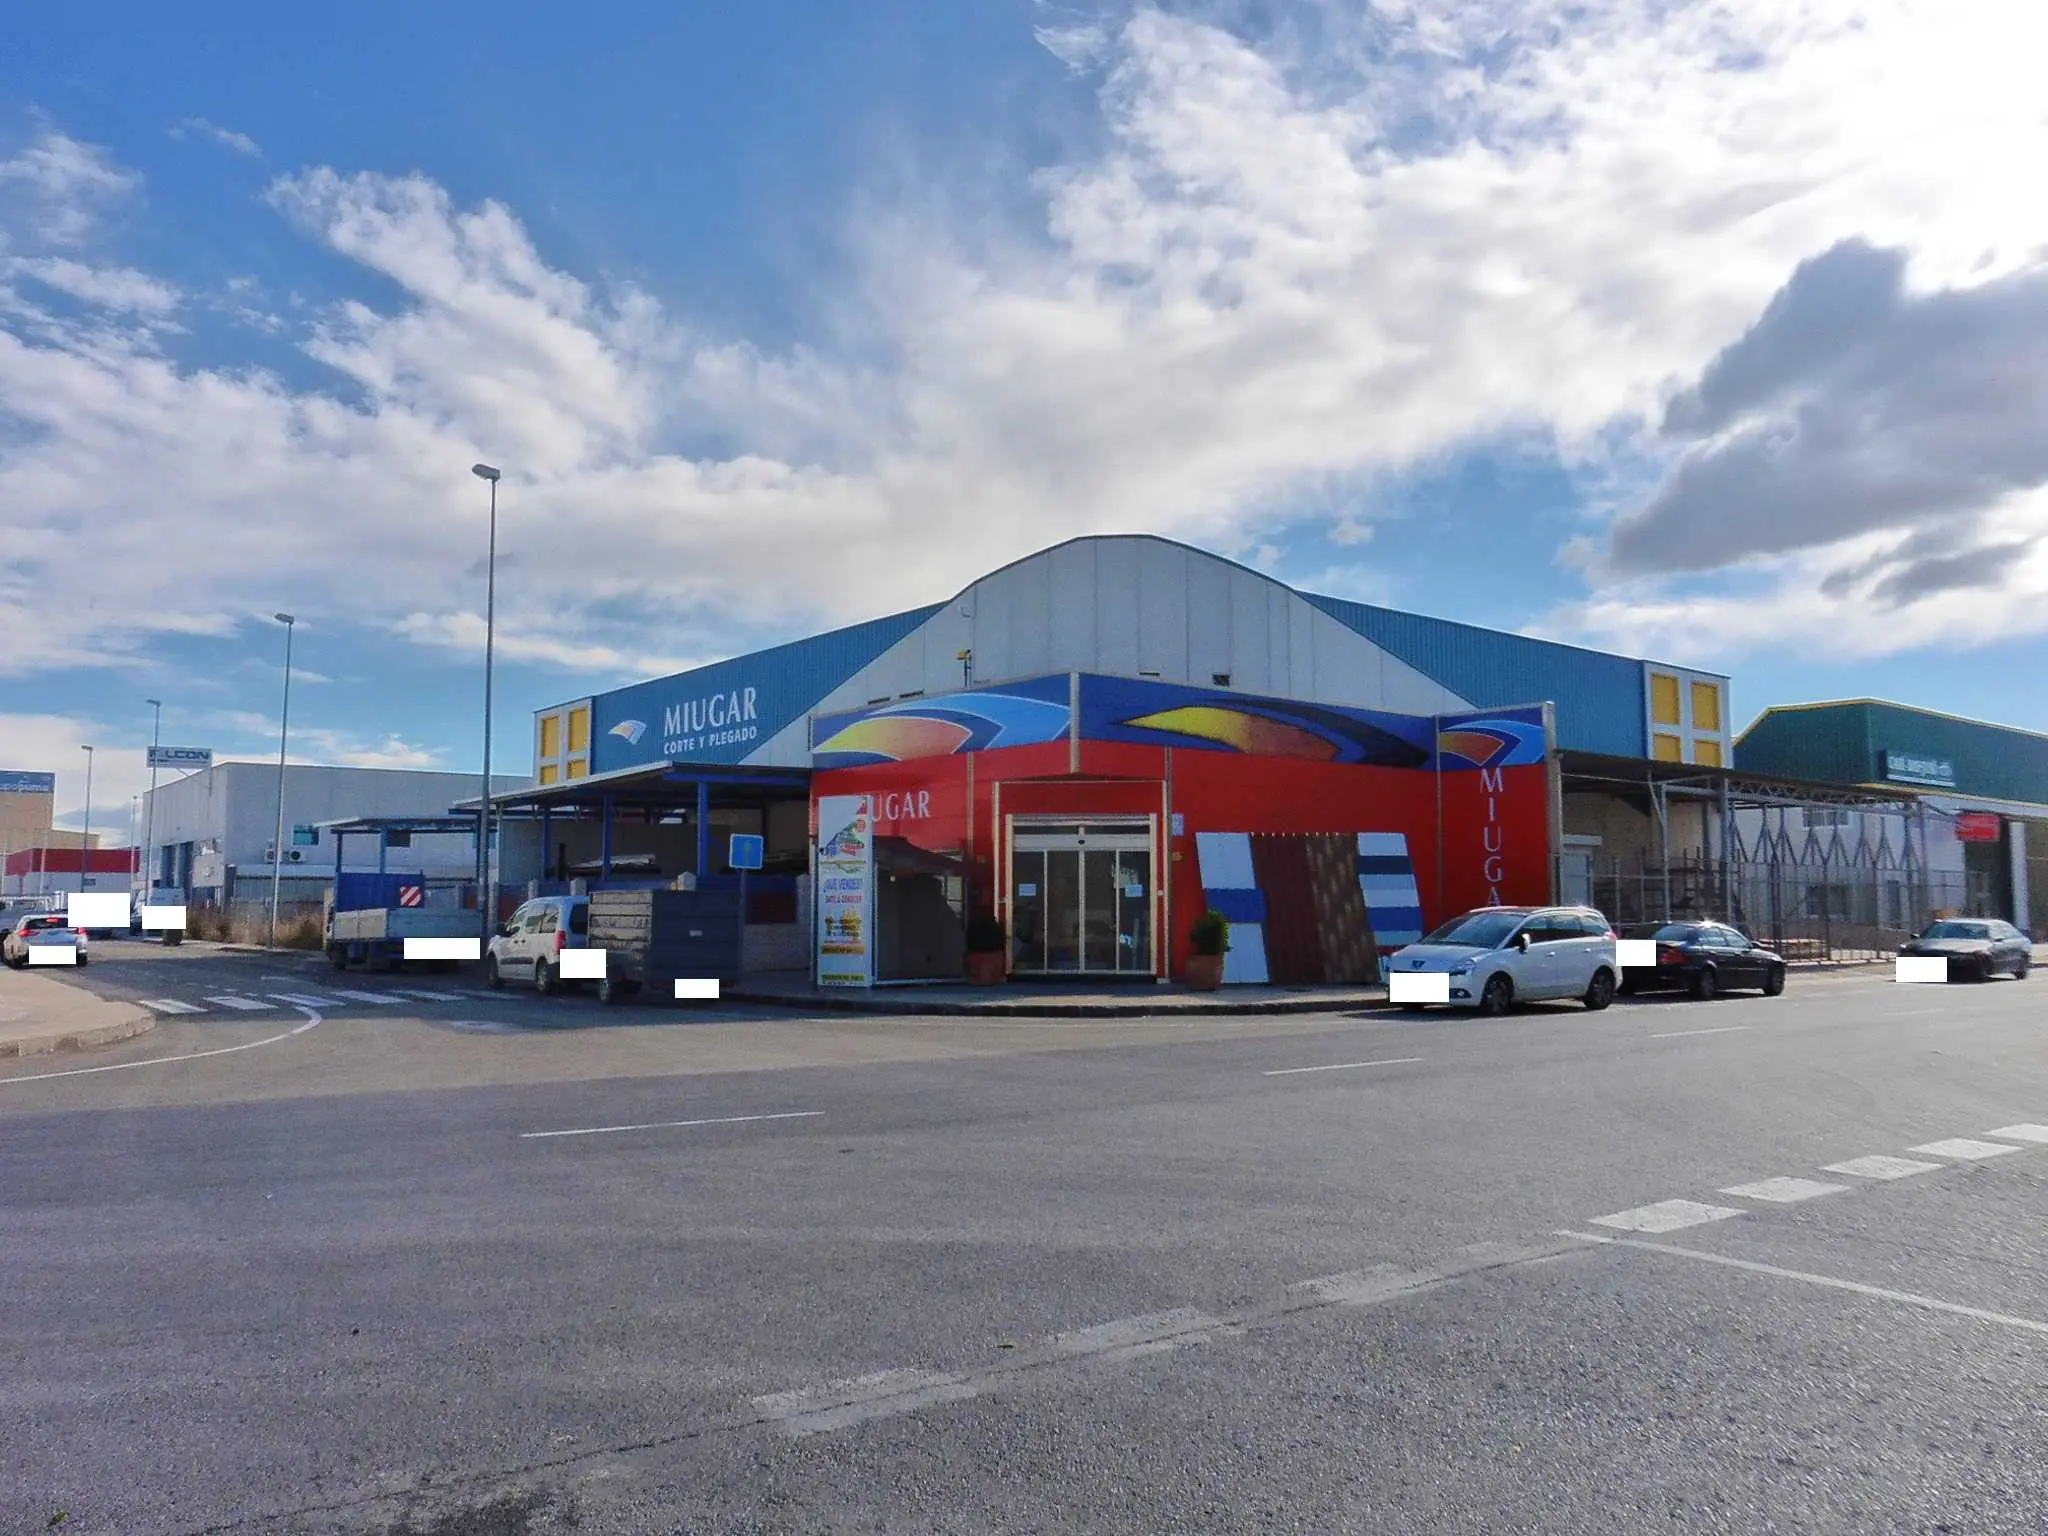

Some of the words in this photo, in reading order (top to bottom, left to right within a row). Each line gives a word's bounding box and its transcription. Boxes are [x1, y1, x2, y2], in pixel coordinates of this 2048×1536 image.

[664, 687, 757, 737] MIUGAR
[664, 738, 695, 755] CORTE
[699, 736, 705, 749] Y
[709, 726, 757, 747] PLEGADO
[871, 791, 930, 822] UGAR
[1480, 767, 1503, 907] MIUGA
